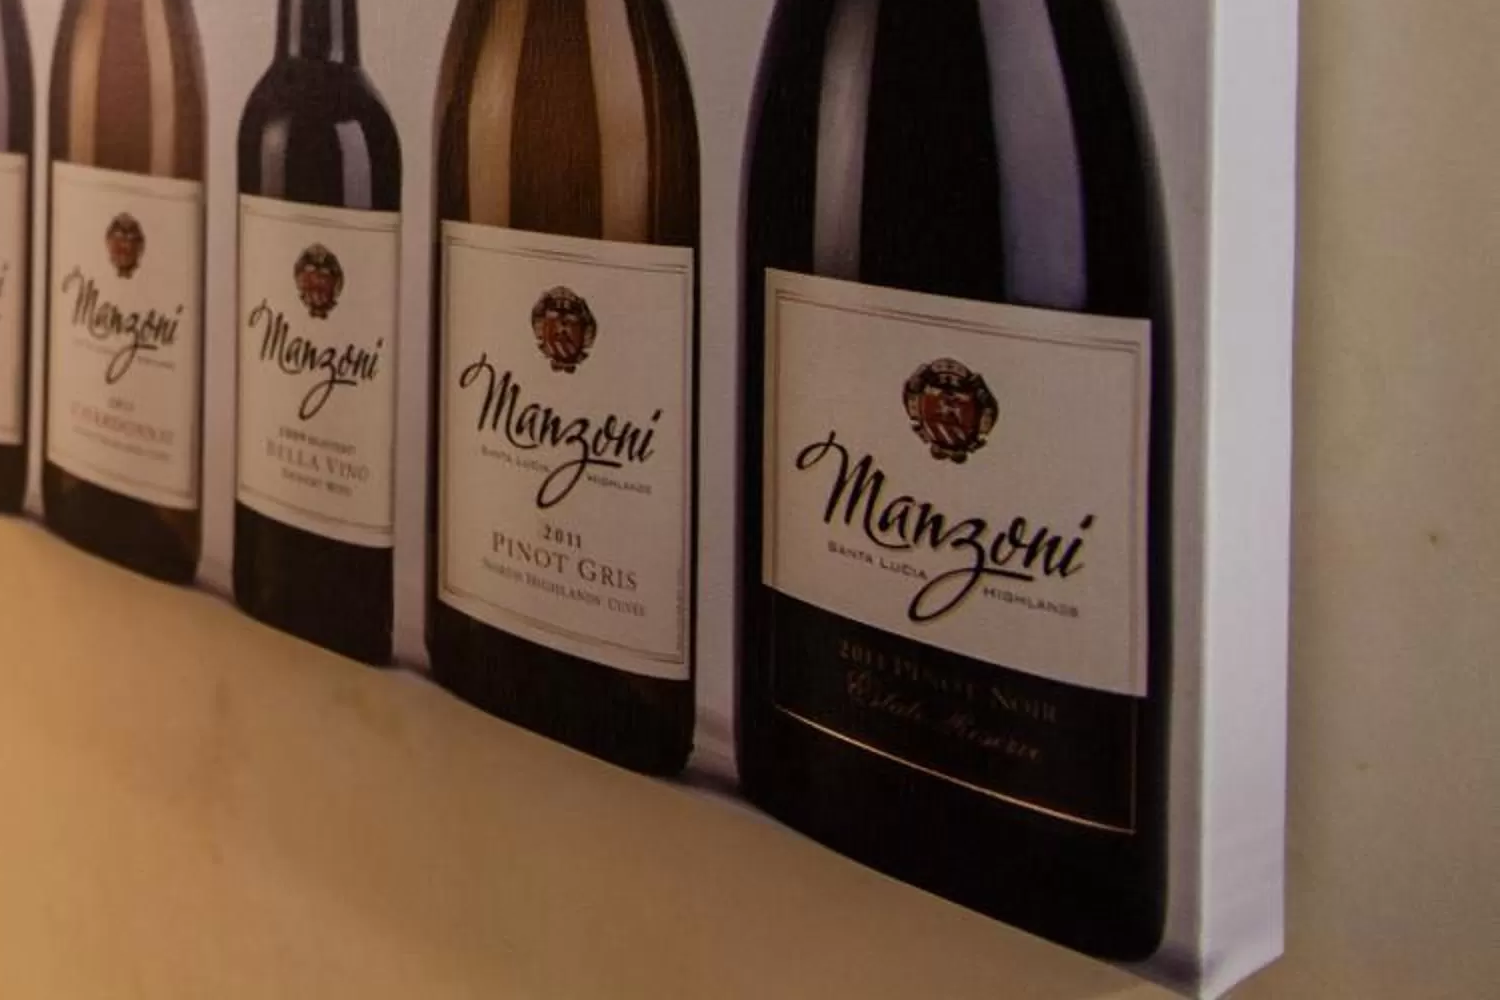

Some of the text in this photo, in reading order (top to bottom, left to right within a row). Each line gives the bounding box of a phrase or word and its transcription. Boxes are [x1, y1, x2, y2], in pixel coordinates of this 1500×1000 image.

[62, 265, 185, 385] Manzoni
[248, 298, 384, 421] Manzoni
[459, 352, 663, 509] Manzoni
[491, 530, 570, 574] PINOT
[577, 556, 638, 591] GRIS
[542, 523, 582, 550] 2011
[796, 430, 1096, 623] Manzoni
[827, 538, 873, 565] SANTA
[878, 556, 929, 581] LUCIA
